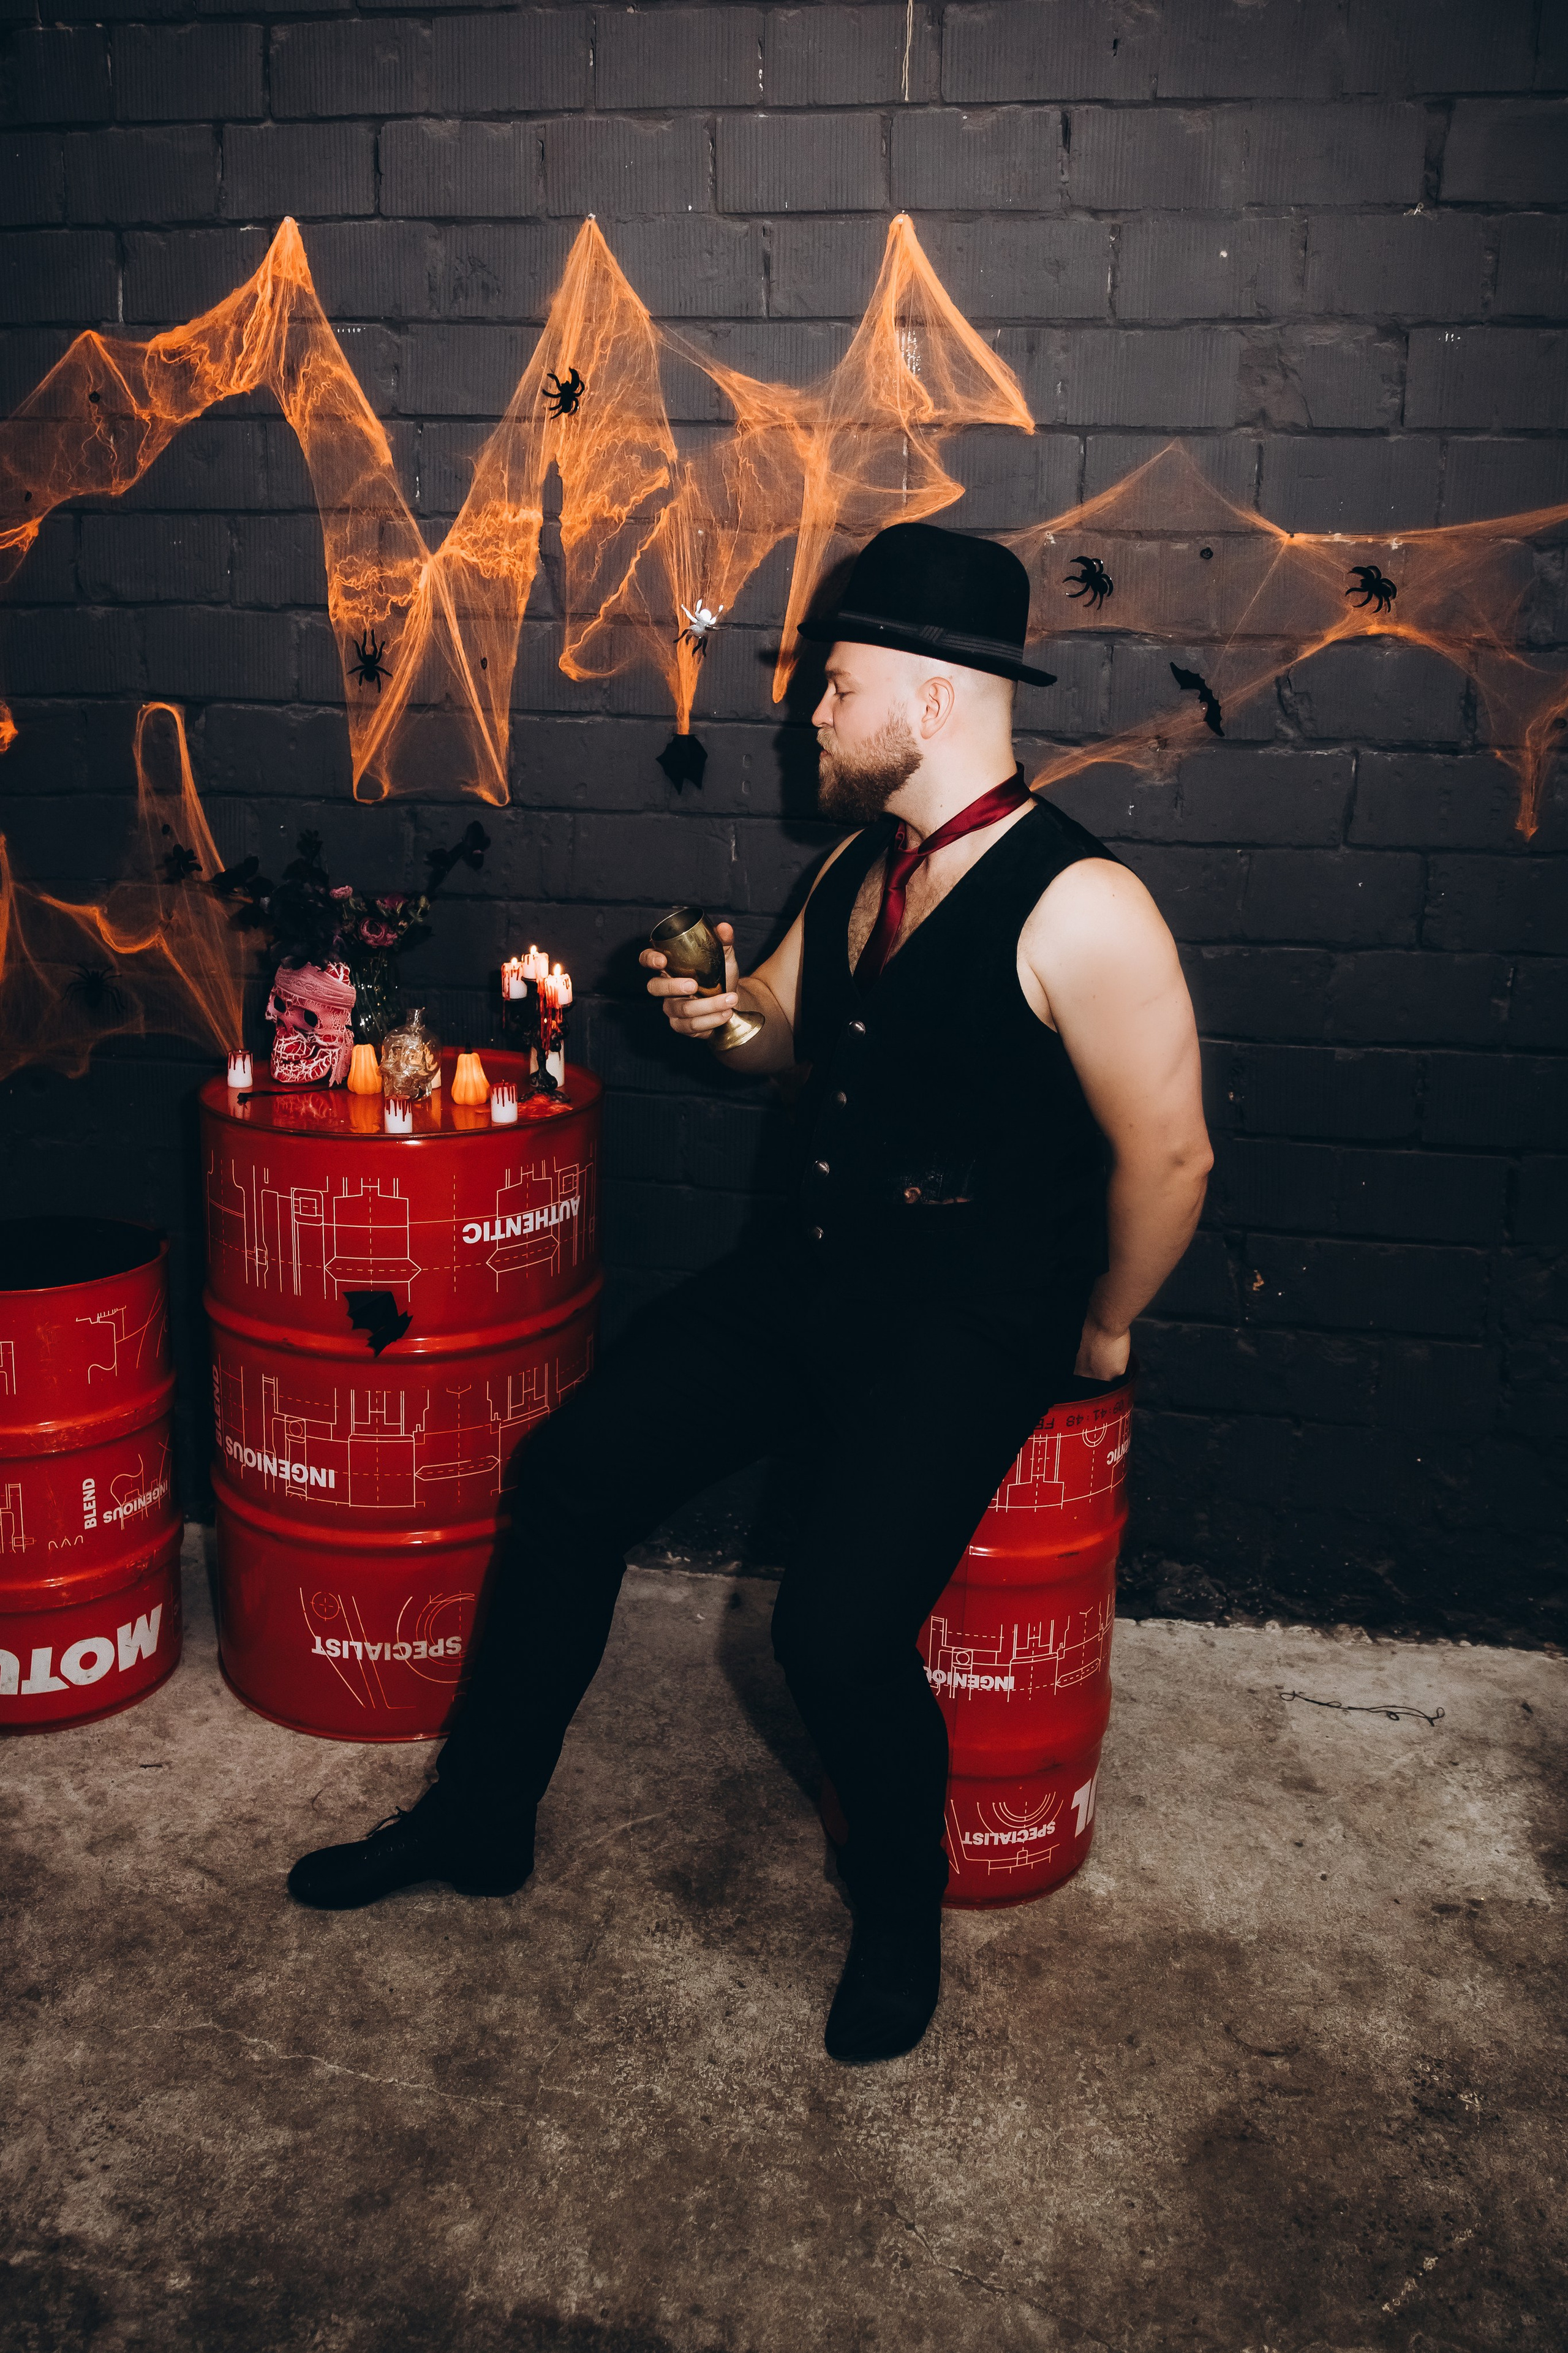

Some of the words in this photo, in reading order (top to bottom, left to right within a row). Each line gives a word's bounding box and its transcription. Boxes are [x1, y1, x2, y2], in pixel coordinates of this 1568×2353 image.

[462, 1195, 581, 1244] AUTHENTIC
[212, 1365, 223, 1448] BLEND
[225, 1435, 335, 1489] INGENIOUS
[82, 1478, 97, 1530] BLEND
[102, 1479, 168, 1524] INGENIOUS
[311, 1636, 462, 1661] SPECIALIST
[961, 1821, 1056, 1846] SPECIALIST
